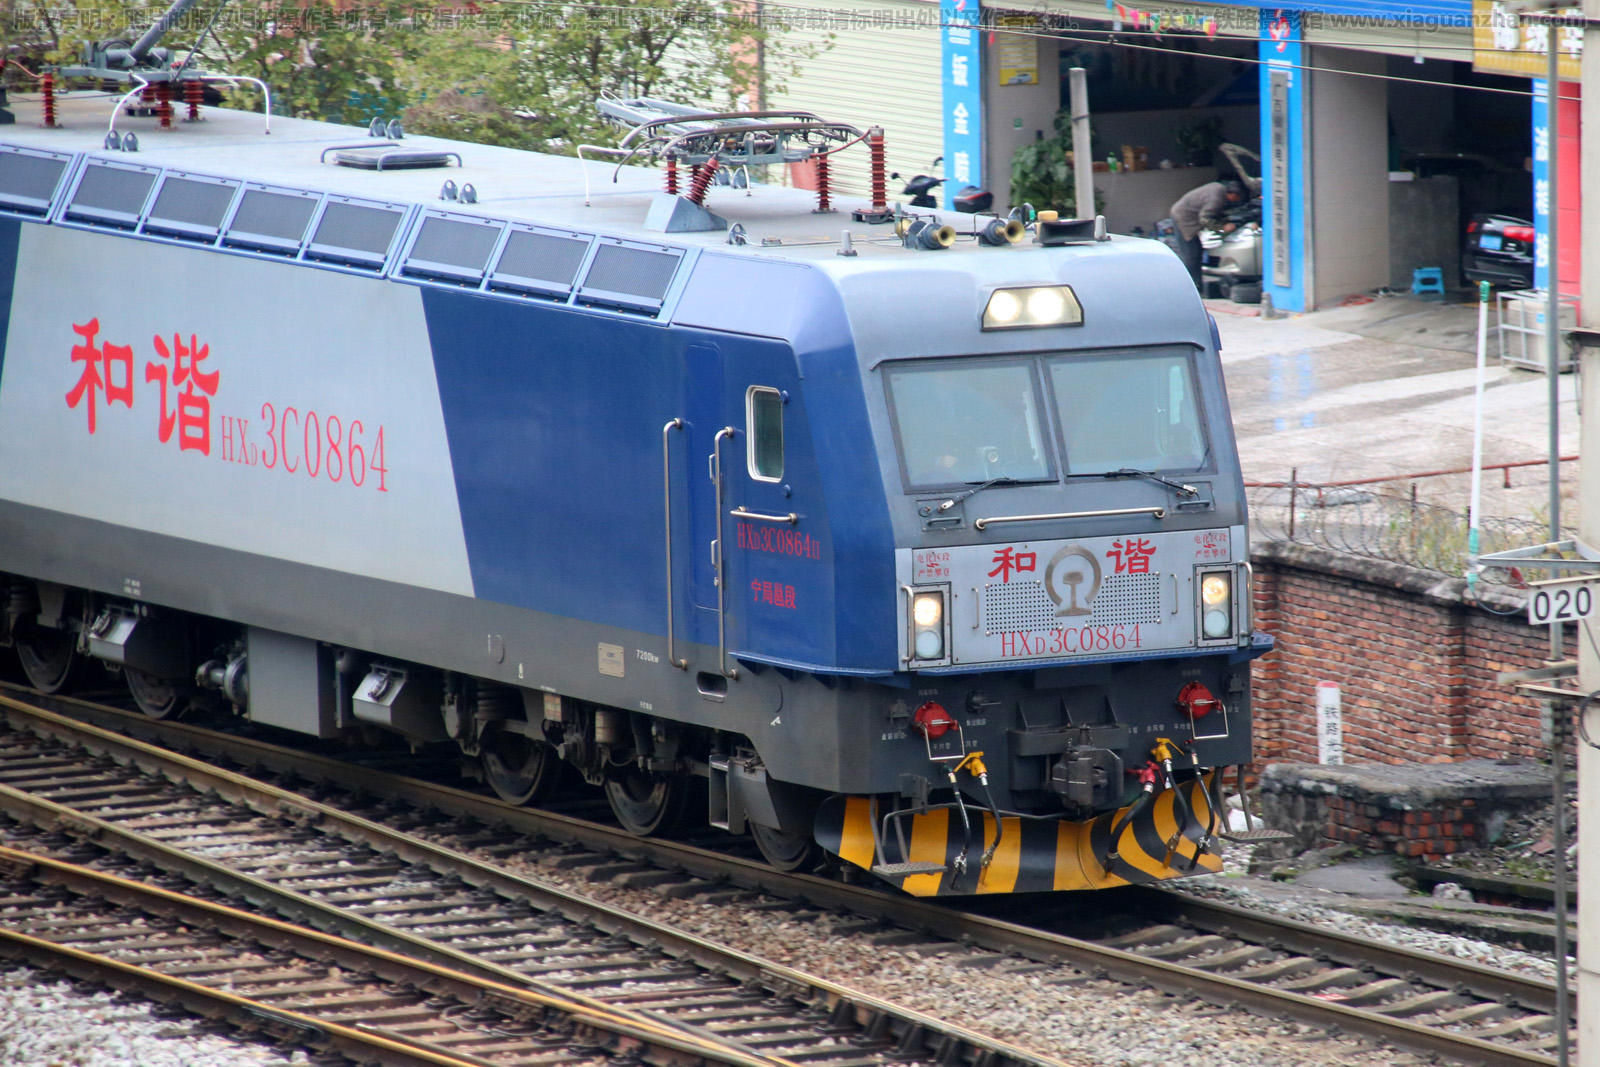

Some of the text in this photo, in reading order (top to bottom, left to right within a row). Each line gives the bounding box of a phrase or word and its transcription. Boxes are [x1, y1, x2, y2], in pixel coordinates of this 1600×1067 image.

[65, 317, 389, 493] 和谐 HXD3C0864
[988, 538, 1157, 583] 和 谐
[750, 578, 797, 609] 宁局邕段
[1532, 586, 1592, 621] 020
[1000, 624, 1143, 658] HXD3C0864
